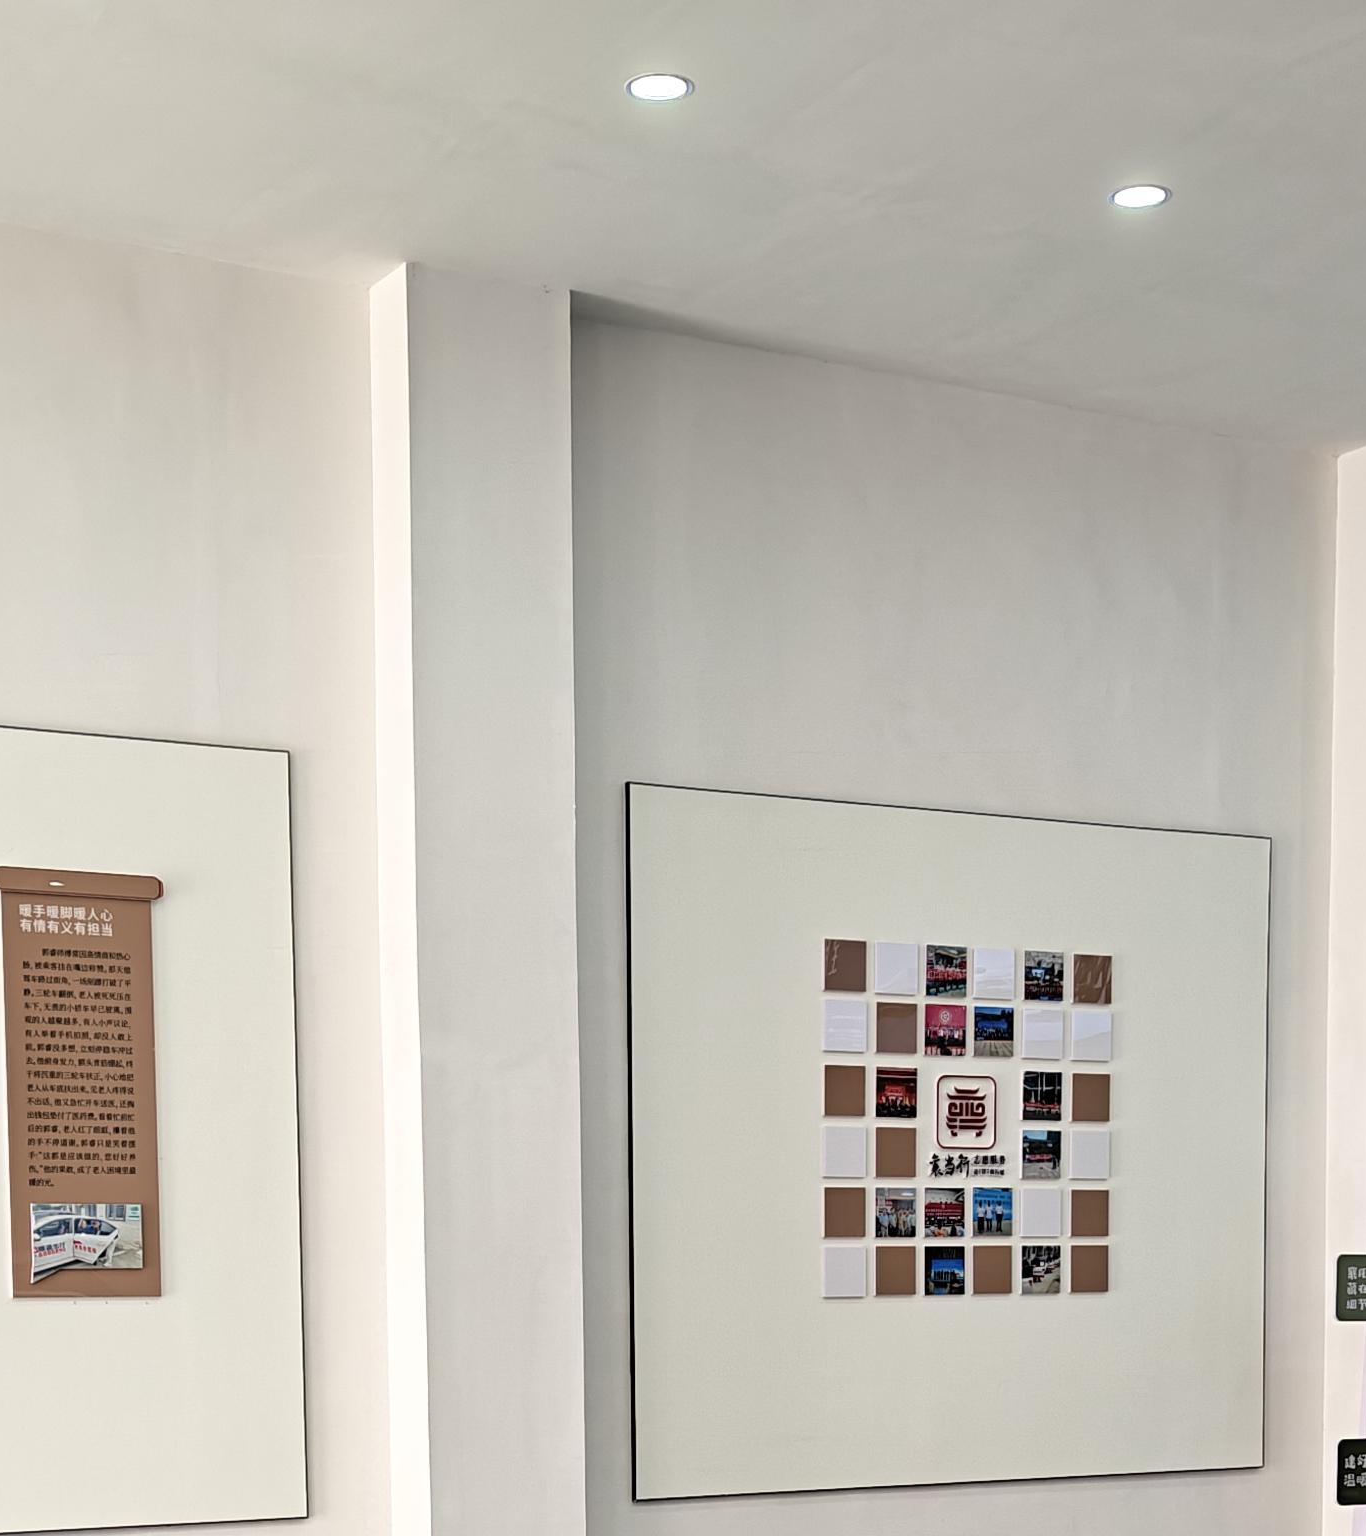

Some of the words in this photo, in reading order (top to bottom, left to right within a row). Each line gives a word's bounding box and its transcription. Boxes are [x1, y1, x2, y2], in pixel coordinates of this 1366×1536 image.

[18, 903, 114, 922] 暖手暖脚暖人心
[19, 918, 113, 937] 有情有义有担当
